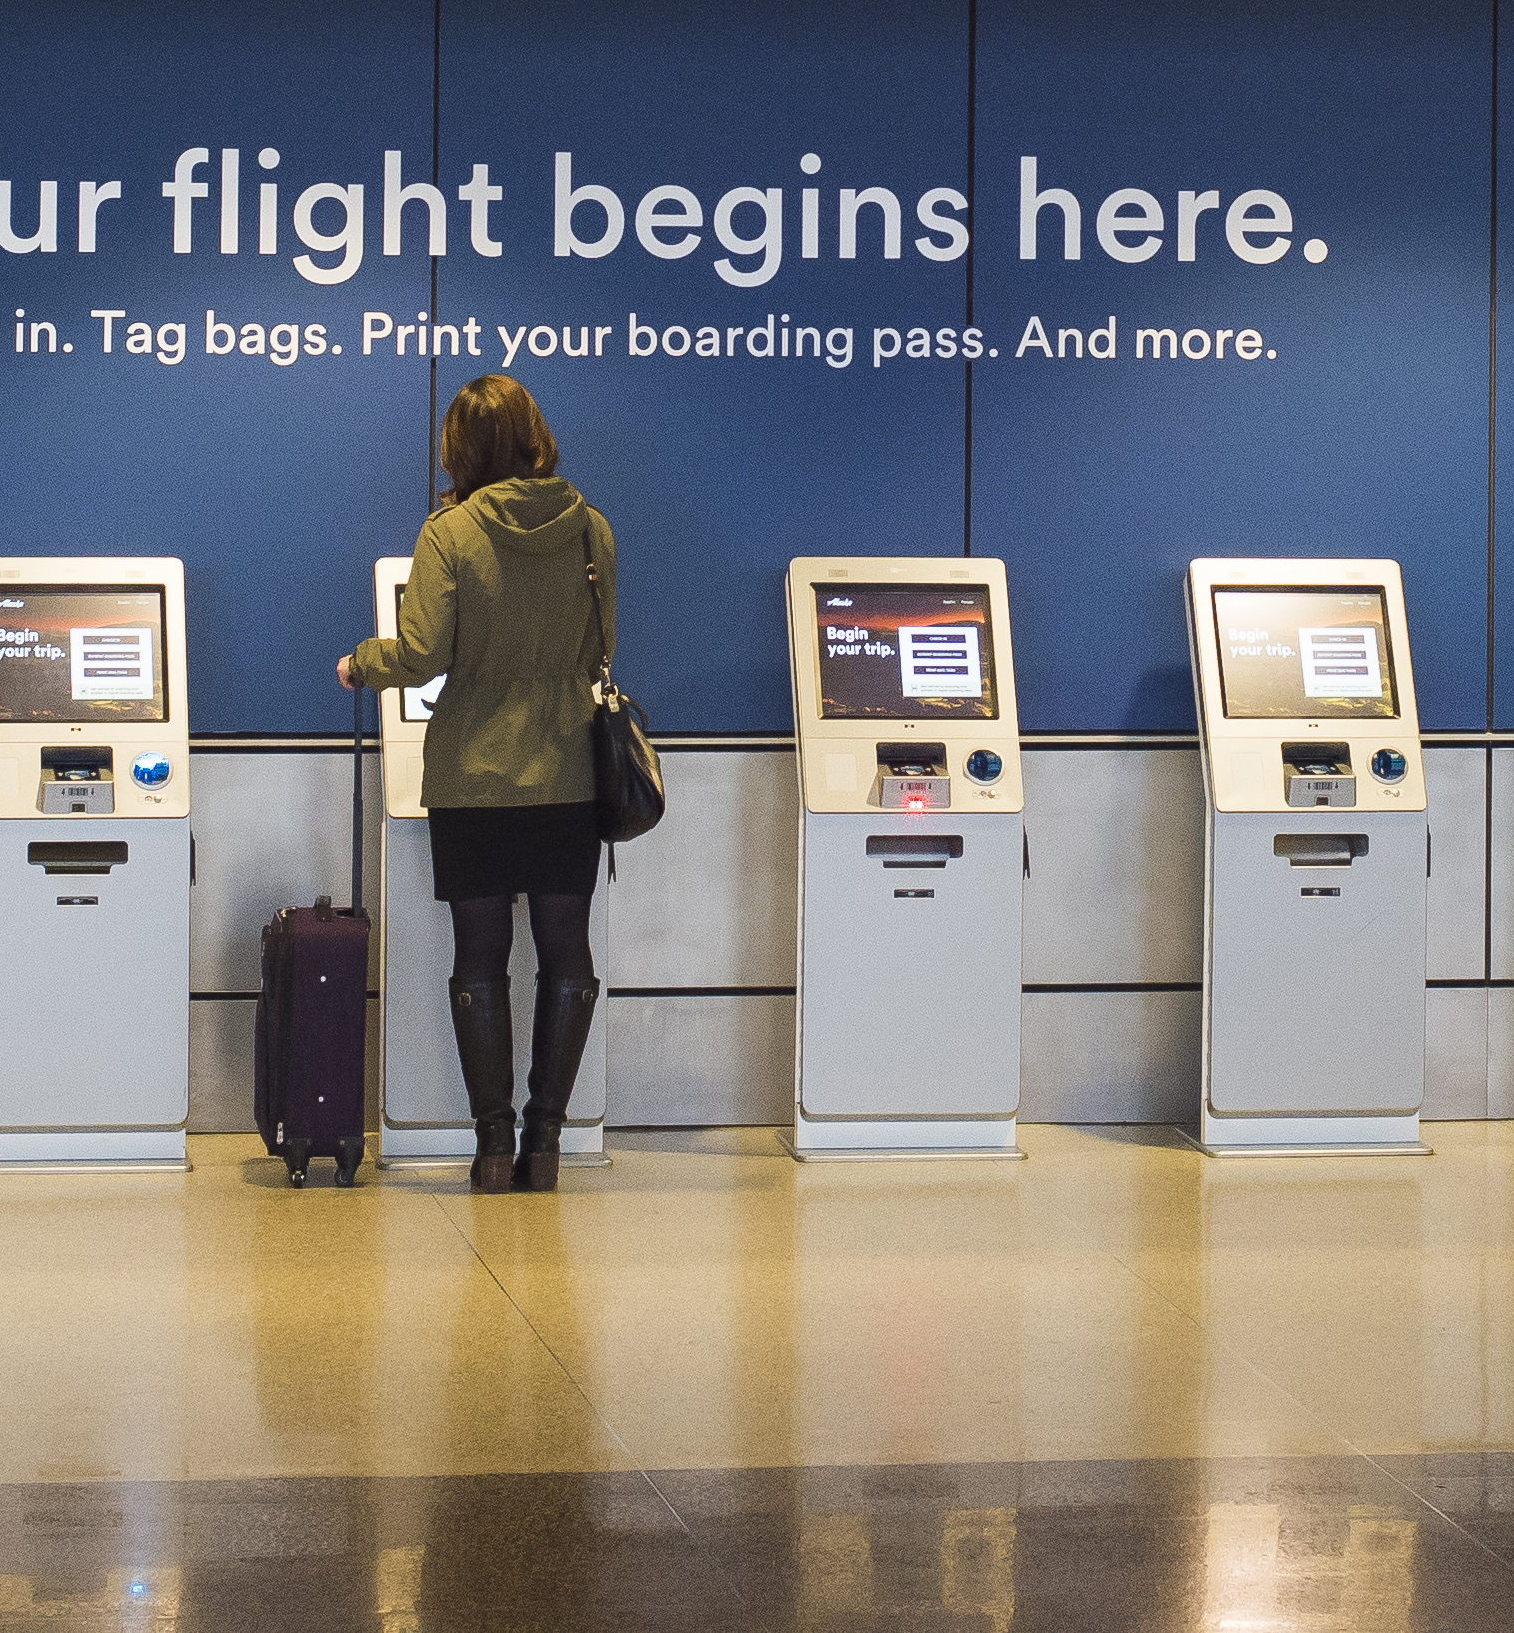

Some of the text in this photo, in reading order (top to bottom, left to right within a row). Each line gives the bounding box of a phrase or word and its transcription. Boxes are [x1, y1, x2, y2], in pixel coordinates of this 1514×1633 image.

[161, 147, 503, 285] flight
[553, 151, 970, 288] begins
[1019, 155, 1329, 265] here.
[15, 308, 74, 353] in.
[90, 309, 187, 366] Tag
[205, 309, 343, 366] bags.
[362, 311, 482, 356] Print
[496, 325, 613, 368] your
[628, 312, 854, 369] boarding
[873, 327, 999, 368] pass.
[1015, 315, 1117, 359] And
[1135, 328, 1277, 361] more.
[827, 625, 868, 641] Begin
[33, 644, 65, 659] trip.
[828, 641, 894, 657] your trip.
